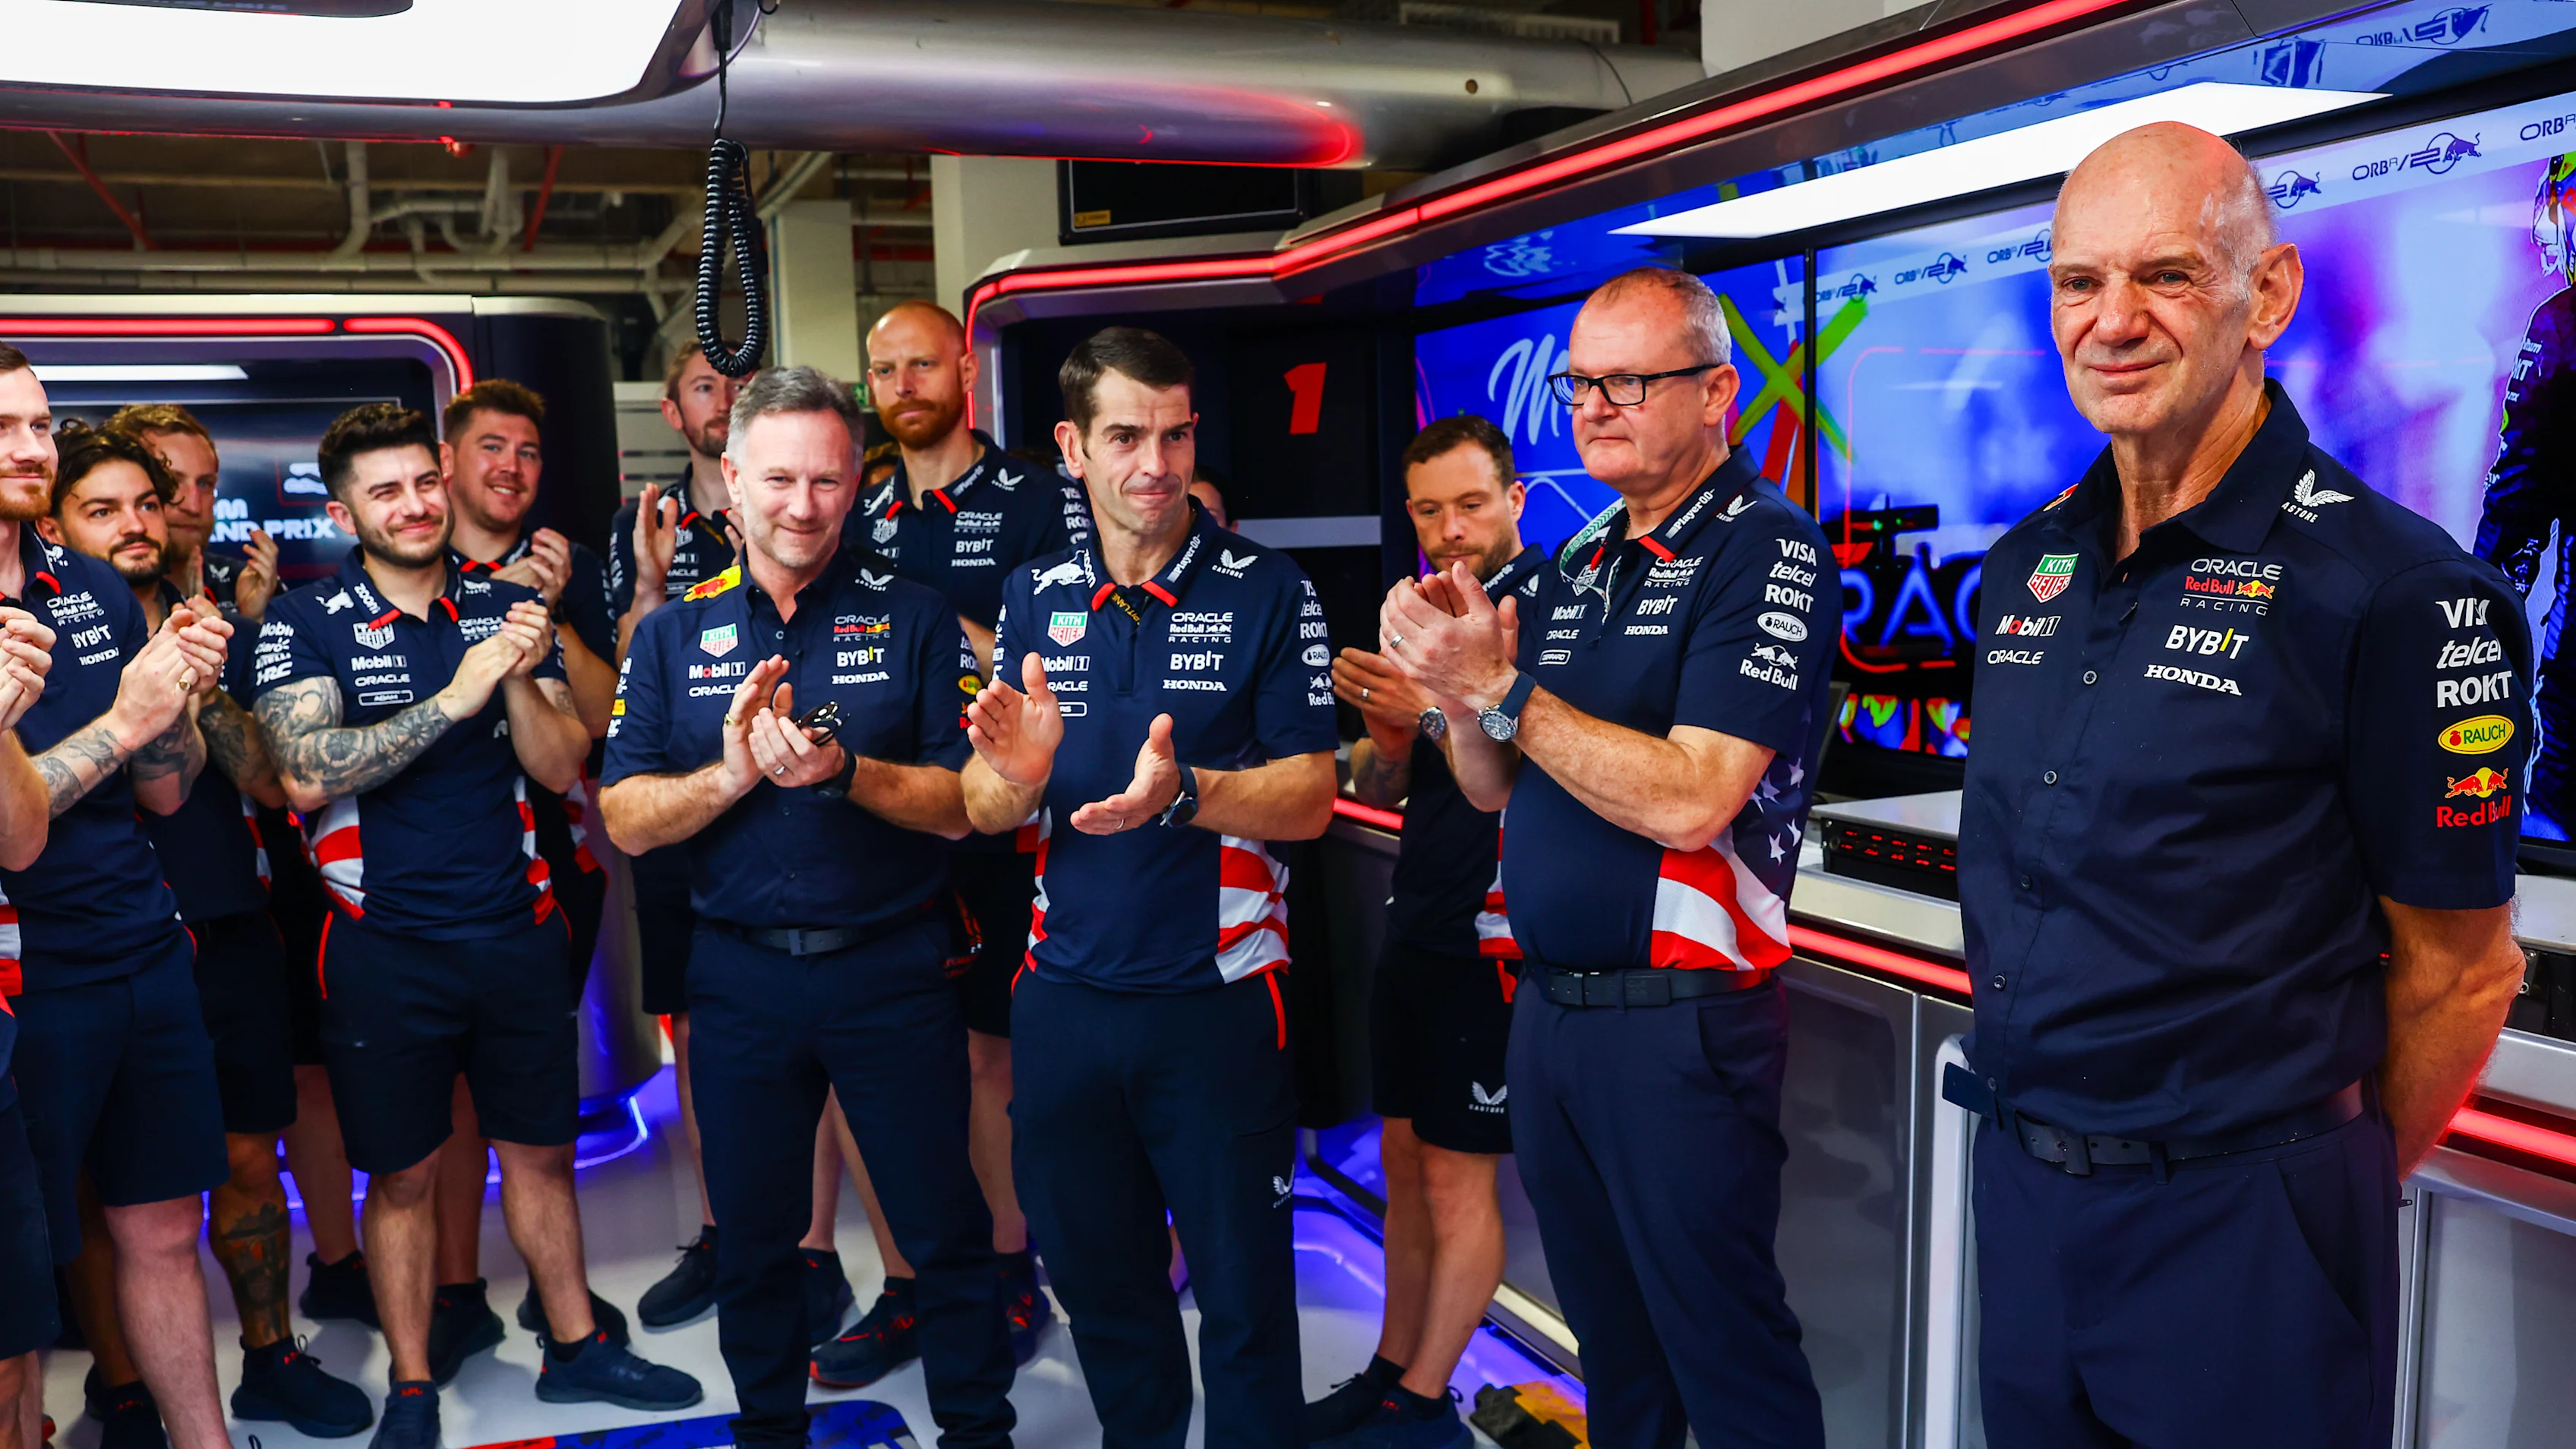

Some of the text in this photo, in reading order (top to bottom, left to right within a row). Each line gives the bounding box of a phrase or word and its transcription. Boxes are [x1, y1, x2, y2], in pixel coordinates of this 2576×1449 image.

[1283, 361, 1327, 434] 1
[957, 511, 1003, 520] ORACLE
[1673, 501, 1703, 530] Player
[2281, 501, 2319, 524] ASTORE
[263, 517, 336, 541] PRIX
[955, 538, 994, 554] BYBIT
[1774, 538, 1817, 567] VISA
[952, 557, 996, 567] HONDA
[1174, 548, 1195, 575] Player
[2044, 558, 2076, 573] KITH
[2190, 558, 2283, 580] ORACLE
[1212, 564, 1245, 579] CASTORE
[1769, 560, 1817, 588] telcel
[1644, 579, 1690, 589] RACING
[2031, 575, 2072, 599] HEUER
[2185, 576, 2235, 595] Red Bull
[353, 582, 381, 615] zoom
[1636, 594, 1679, 616] BYBIT
[1764, 583, 1814, 614] ROKT
[2180, 598, 2268, 617] RACING
[834, 613, 891, 626] ORACLE
[1056, 616, 1082, 627] KITH
[1172, 611, 1234, 623] ORACLE
[2435, 597, 2491, 630] VIS
[833, 623, 866, 634] Red Bull
[1170, 623, 1204, 633] Red Bull
[1545, 629, 1580, 641] ORACLE
[1623, 625, 1669, 636] HONDA
[1773, 619, 1803, 637] RAUCH
[1995, 614, 2046, 637] Mobil
[833, 632, 891, 642] RACING
[1050, 627, 1084, 645] HEUER
[2164, 623, 2250, 660] BYBIT
[351, 655, 393, 672] Mobil
[836, 646, 885, 668] BYBIT
[1041, 655, 1075, 673] Mobil
[1170, 650, 1224, 671] BYBIT
[1987, 649, 2045, 665] ORACLE
[355, 673, 411, 687] ORACLE
[688, 661, 730, 680] Mobil
[832, 671, 891, 685] HONDA
[1739, 658, 1799, 691] Red Bull
[2143, 664, 2243, 696] HONDA
[1047, 680, 1089, 693] RACLE
[1162, 679, 1228, 692] HONDA
[2436, 670, 2513, 709] ROKT
[2464, 723, 2506, 745] RAUCH
[2436, 801, 2486, 828] Red
